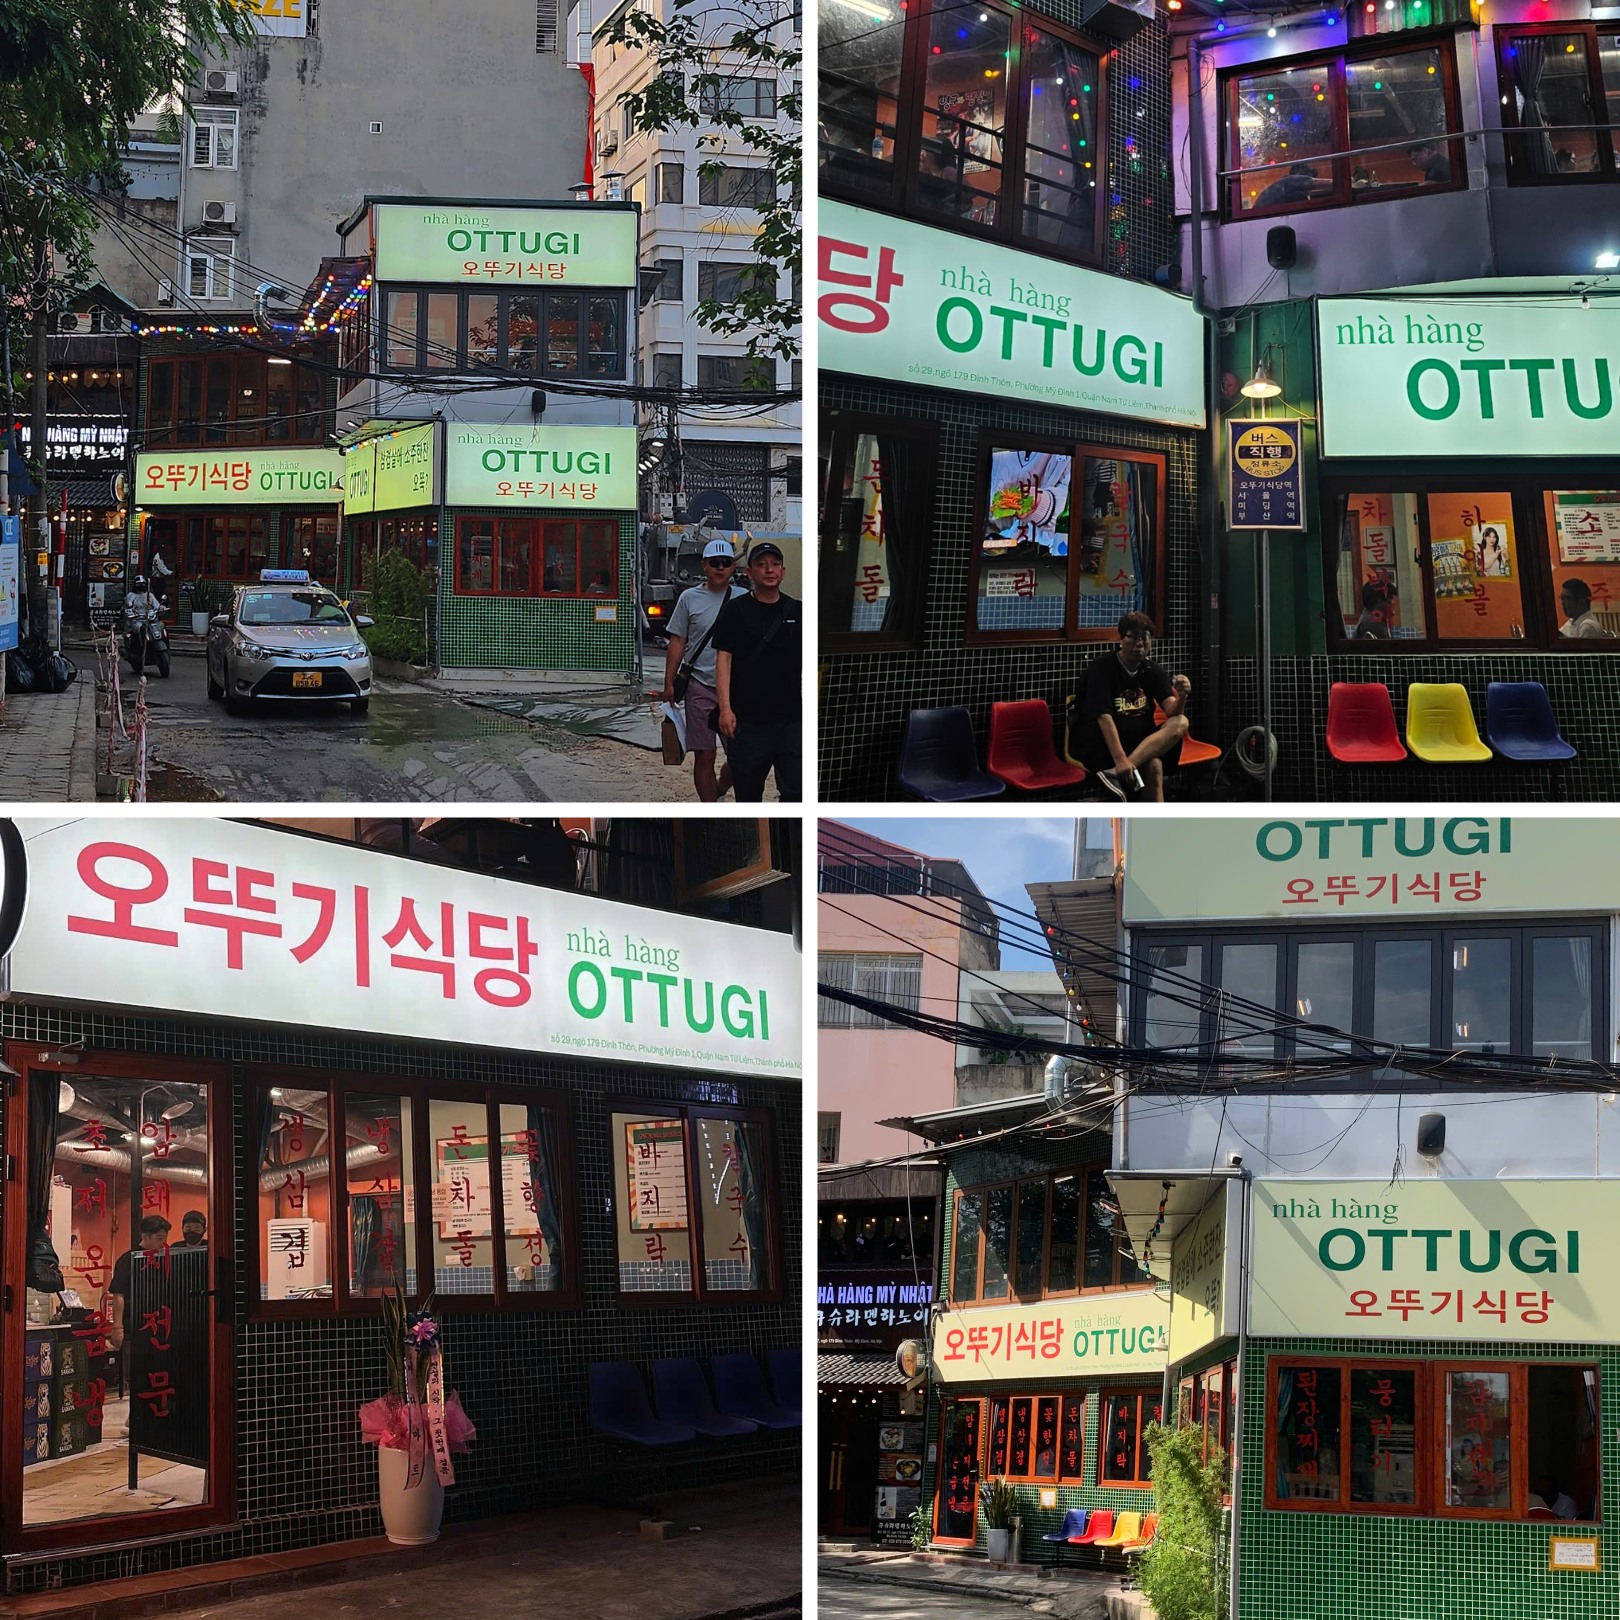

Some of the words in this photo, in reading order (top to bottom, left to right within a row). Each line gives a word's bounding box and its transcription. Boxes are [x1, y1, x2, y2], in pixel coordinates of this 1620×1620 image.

[423, 213, 450, 226] nhà
[454, 213, 490, 228] hàng
[447, 229, 580, 255] OTTUGI
[461, 261, 567, 280] 오뚜기식당
[940, 266, 993, 297] nhà
[1008, 277, 1071, 317] hàng
[936, 297, 1163, 388] OTTUGI
[1336, 314, 1395, 345] nhà
[1404, 314, 1485, 352] hàng
[954, 371, 969, 381] 179
[1407, 358, 1620, 421] OTTU
[100, 424, 129, 446] NHẬT
[457, 433, 484, 445] nhà
[487, 433, 523, 448] hàng
[1251, 432, 1279, 445] 버스
[481, 449, 611, 475] OTTUGI
[1250, 446, 1282, 458] 직행
[1250, 460, 1281, 468] 정류소
[145, 461, 252, 492] 오뚜기식당
[278, 461, 300, 472] hàng
[1244, 466, 1262, 476] BUS
[1263, 465, 1285, 477] STOP
[260, 471, 334, 491] OTTUGI
[496, 481, 599, 500] 오뚜기식당
[1240, 481, 1292, 490] 오뚜기식당역
[1256, 818, 1511, 862] OTTUGI
[1282, 870, 1487, 906] 오뚜기식당
[68, 841, 538, 1008] 오뚜기식당
[566, 927, 612, 958] nhà
[624, 935, 680, 972] hàng
[567, 961, 770, 1041] OTTUGI
[587, 1038, 600, 1048] 179
[446, 1125, 477, 1268] 돈차돌
[638, 1136, 667, 1265] 바지락
[1272, 1198, 1322, 1219] nhà
[1331, 1198, 1399, 1225] hàng
[1318, 1228, 1580, 1274] OTTUGI
[837, 1282, 874, 1304] HÀNG
[876, 1281, 897, 1304] MỲ
[1345, 1289, 1554, 1324] 오뚜기식당
[1074, 1315, 1092, 1329] nhà
[1096, 1314, 1121, 1328] hàng
[943, 1318, 1064, 1363] 오뚜기식당
[1073, 1325, 1163, 1358] OTTUGI
[60, 1368, 75, 1376] SAIGON
[59, 1445, 73, 1453] SAIGON
